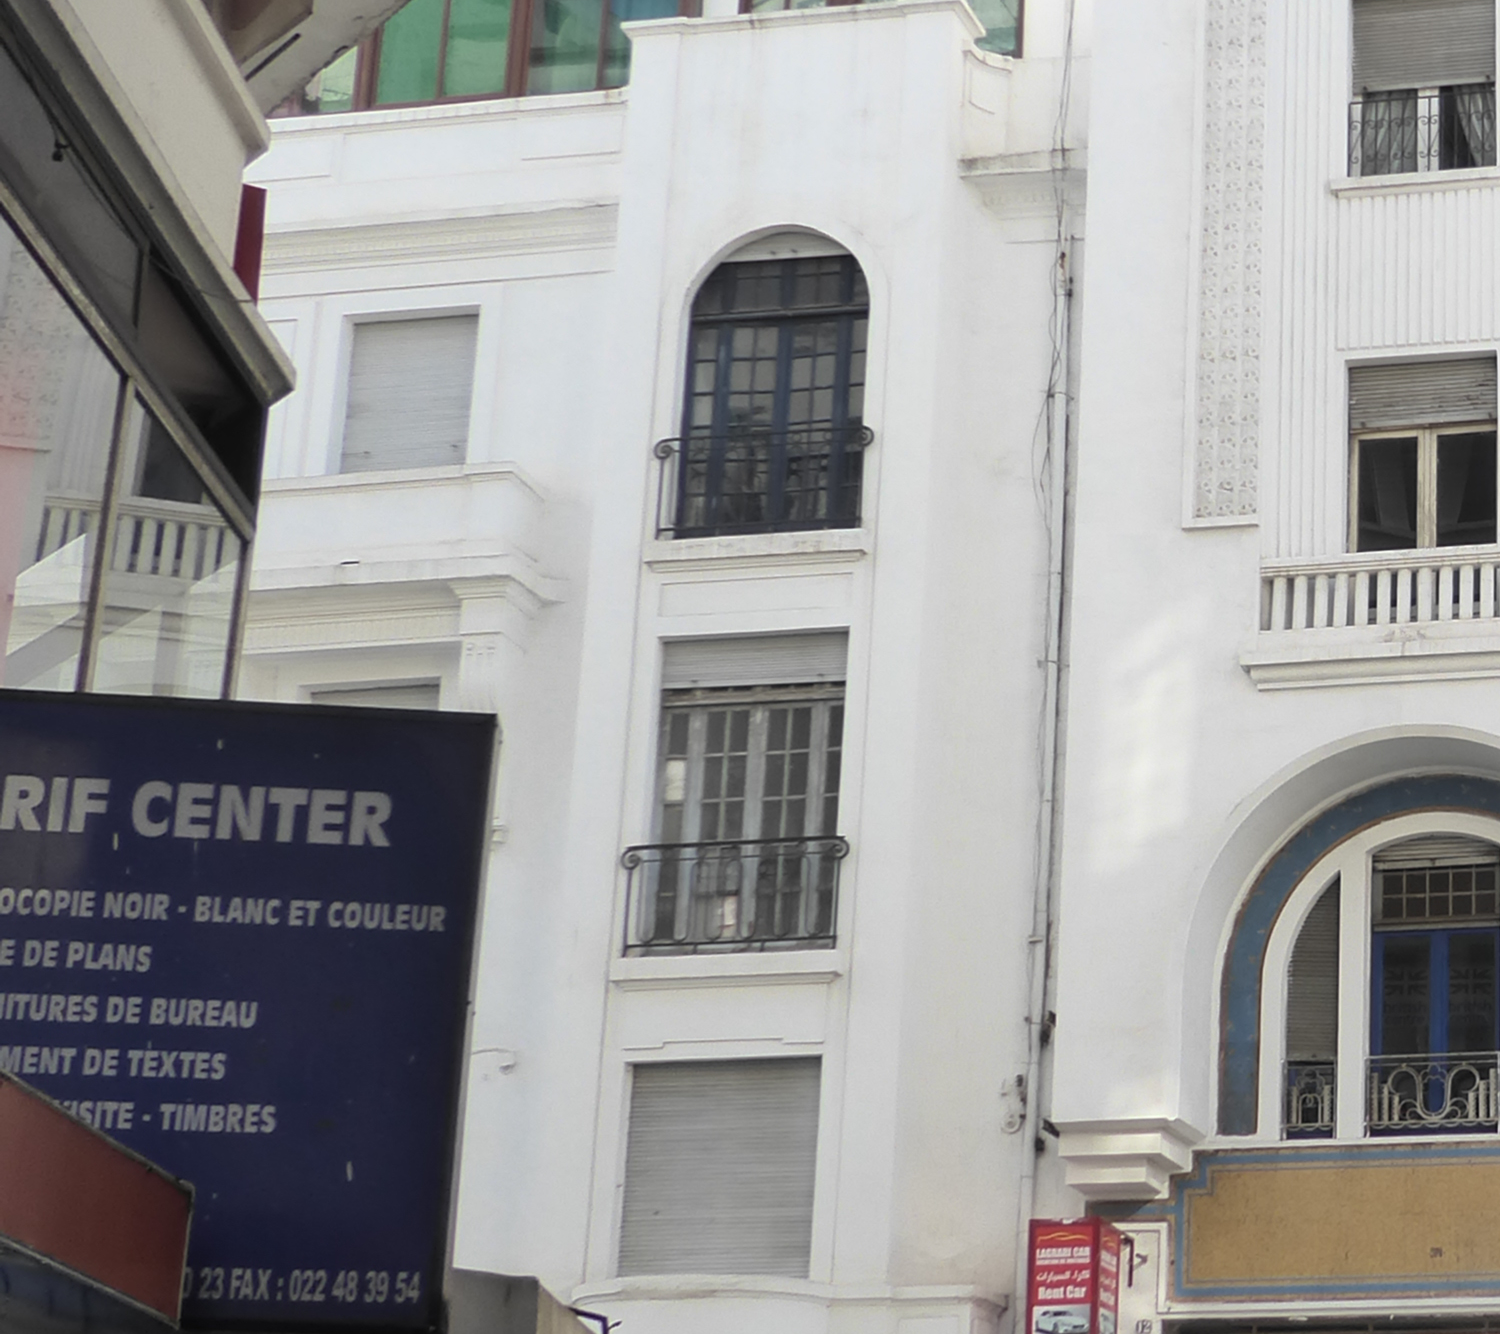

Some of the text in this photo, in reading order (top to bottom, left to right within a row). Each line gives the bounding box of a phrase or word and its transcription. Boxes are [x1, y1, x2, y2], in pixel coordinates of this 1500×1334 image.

[0, 774, 392, 847] RIF CENTER
[0, 887, 97, 918] OCOPIE
[103, 891, 170, 921] NOIR
[193, 895, 282, 926] BLANC
[288, 899, 322, 927] ET
[328, 900, 447, 932] COULEUR
[22, 939, 60, 968] DE
[65, 941, 153, 973] PLANS
[106, 996, 143, 1025] DE
[149, 998, 259, 1029] BUREAU
[0, 1045, 228, 1081] MENT DE TEXTES
[159, 1103, 278, 1135] TIMBRES
[197, 1267, 225, 1300] 23
[229, 1268, 272, 1301] FAX
[289, 1269, 328, 1303] 022
[331, 1270, 359, 1303] 48
[364, 1270, 390, 1304] 39
[394, 1270, 421, 1304] 54
[1038, 1285, 1087, 1300] Rent Car
